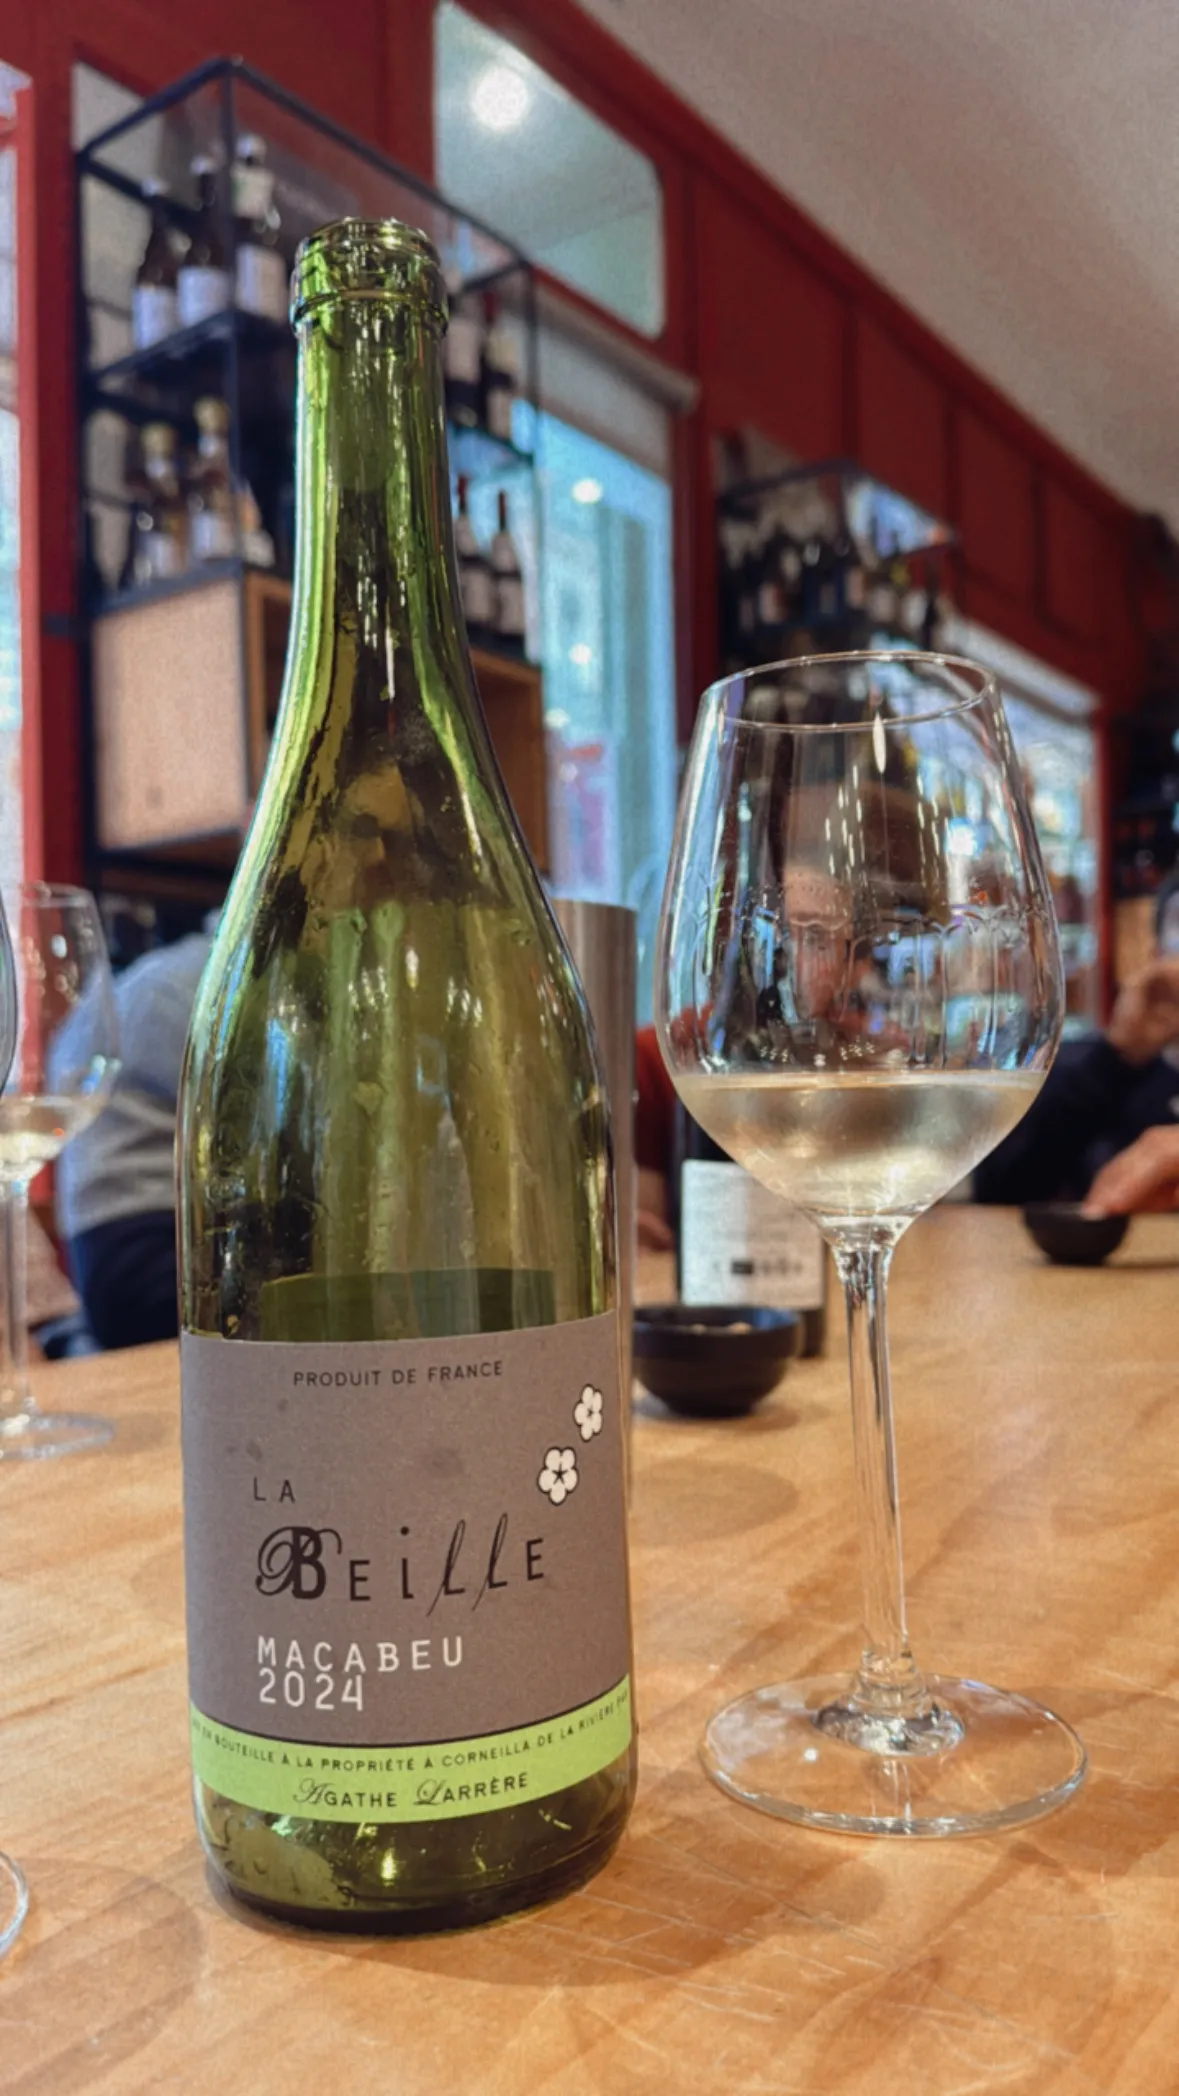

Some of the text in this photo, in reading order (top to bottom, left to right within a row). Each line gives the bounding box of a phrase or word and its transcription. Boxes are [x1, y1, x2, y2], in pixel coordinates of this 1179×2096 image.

[293, 1360, 503, 1386] PRODUIT DE FRANCE
[253, 1477, 295, 1502] LA
[257, 1635, 463, 1673] MACABEU
[258, 1668, 364, 1711] 2024
[215, 1734, 274, 1763] BOUTEILLE
[297, 1756, 313, 1768] LA
[321, 1757, 415, 1772] PROPRIÉTÉ
[442, 1740, 530, 1767] CORNEILLA
[537, 1733, 552, 1747] DE
[560, 1725, 574, 1739] LA
[293, 1771, 528, 1808] AGATHE LARRÈRE
